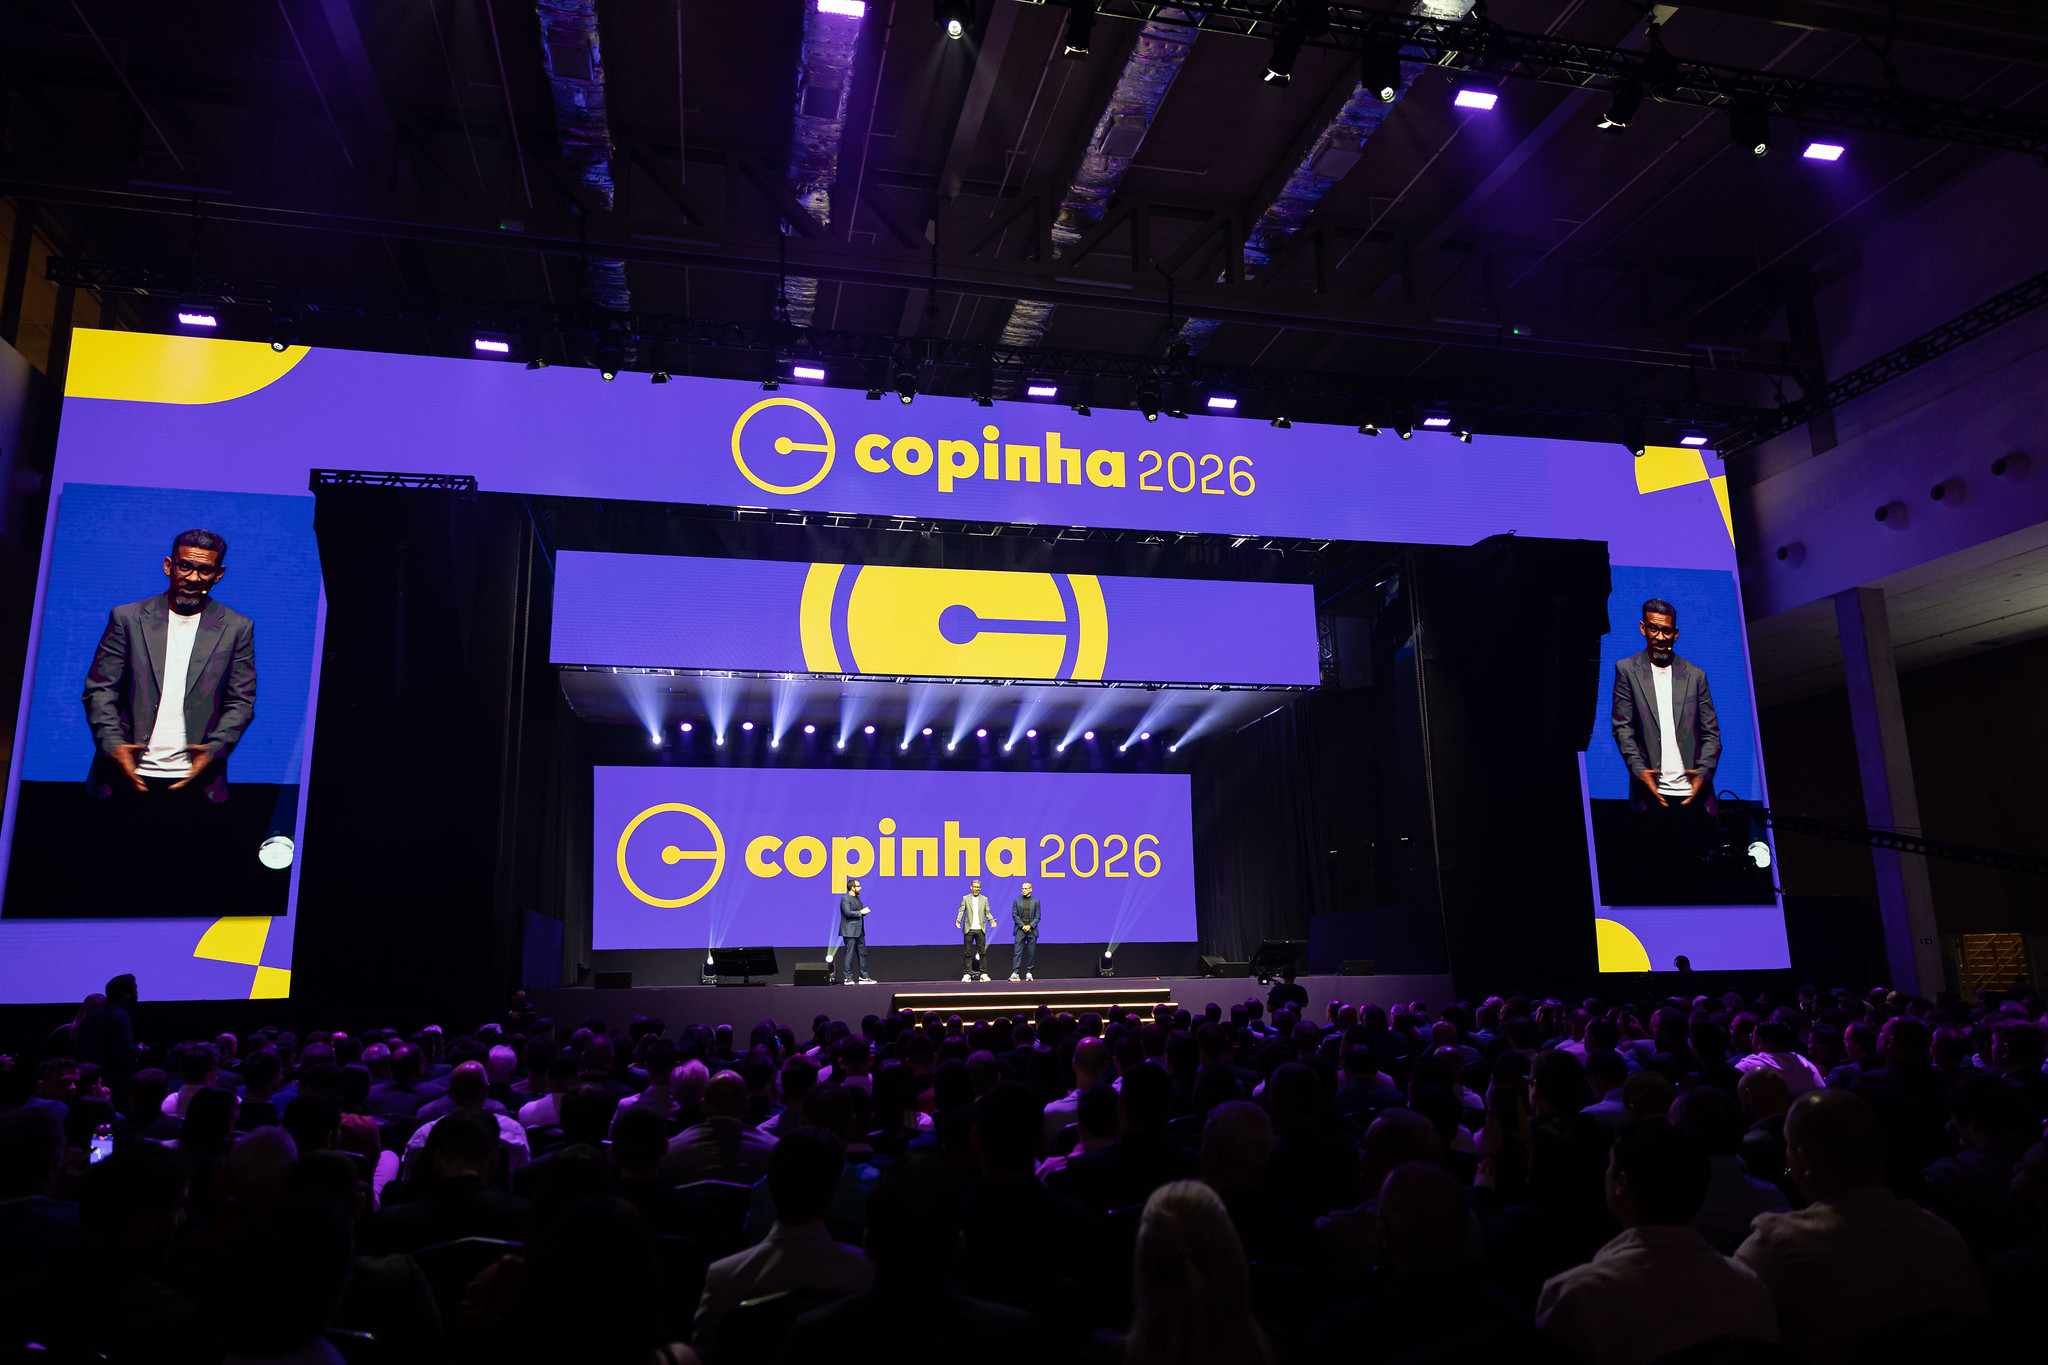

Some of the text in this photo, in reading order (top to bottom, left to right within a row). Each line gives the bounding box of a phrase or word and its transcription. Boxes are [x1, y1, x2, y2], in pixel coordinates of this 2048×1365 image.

[854, 425, 1256, 497] copinha 2026
[744, 817, 1162, 894] copinha 2026
